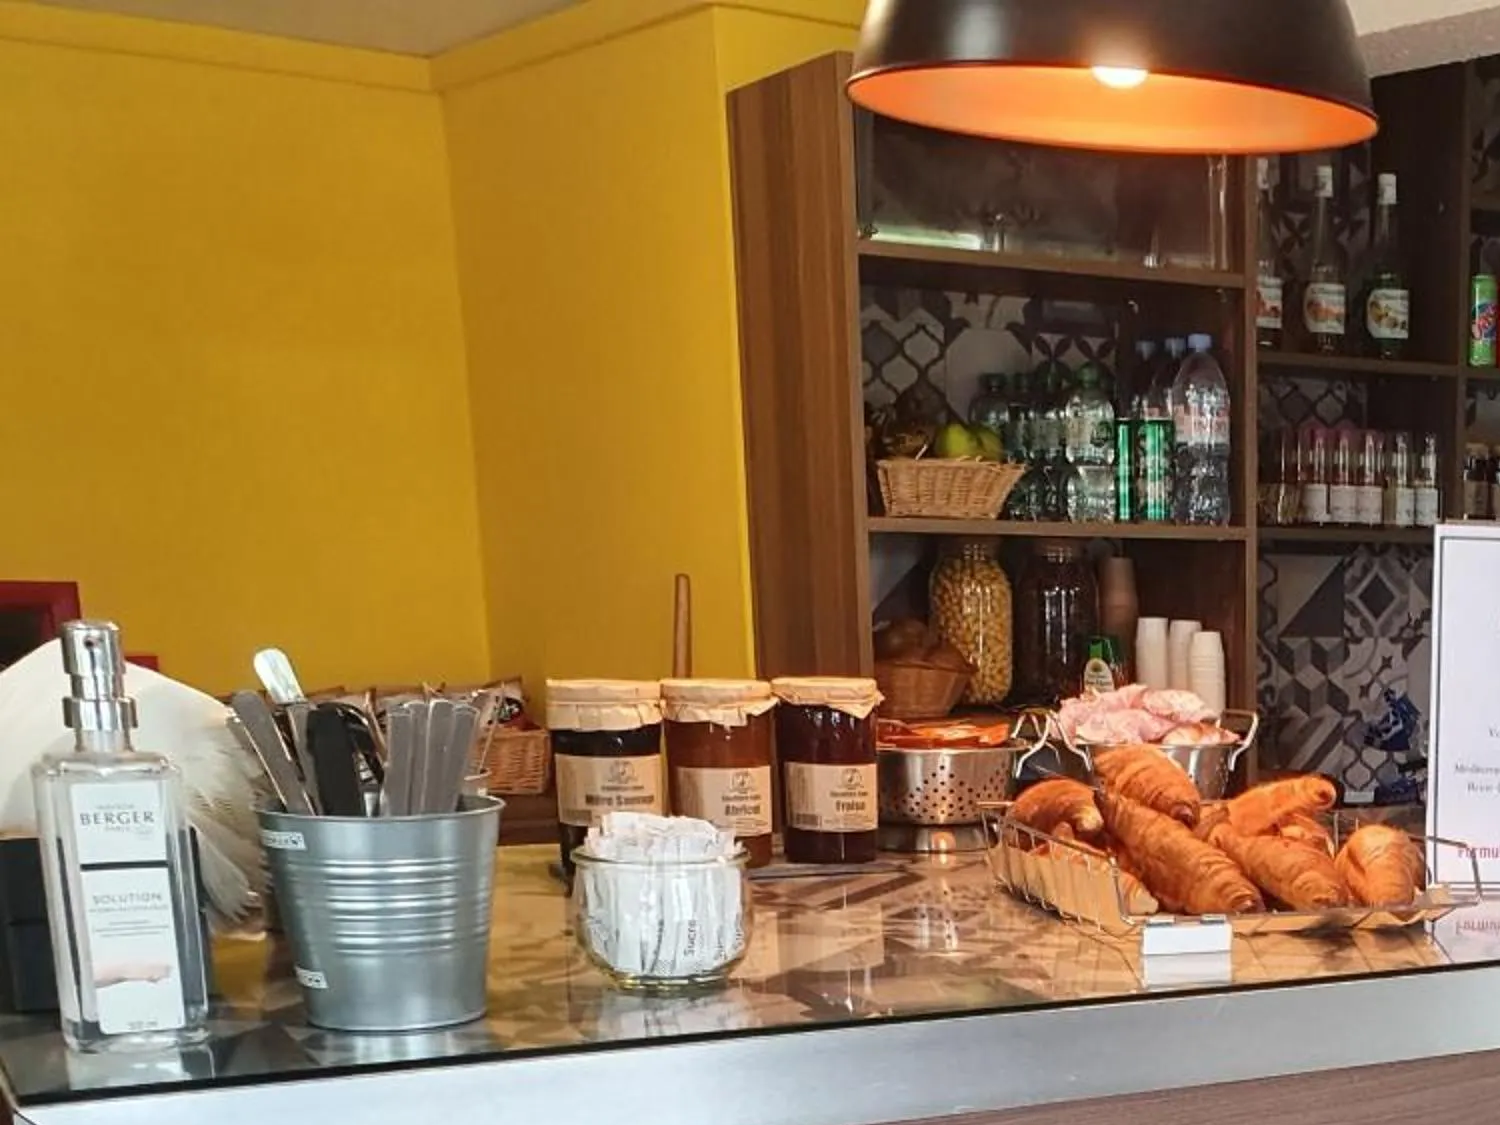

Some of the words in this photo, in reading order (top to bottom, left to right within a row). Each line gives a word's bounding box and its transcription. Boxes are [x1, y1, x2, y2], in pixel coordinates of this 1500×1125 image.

[79, 810, 155, 826] BERGER
[92, 892, 163, 906] SOLUTION
[684, 919, 697, 956] Sucre
